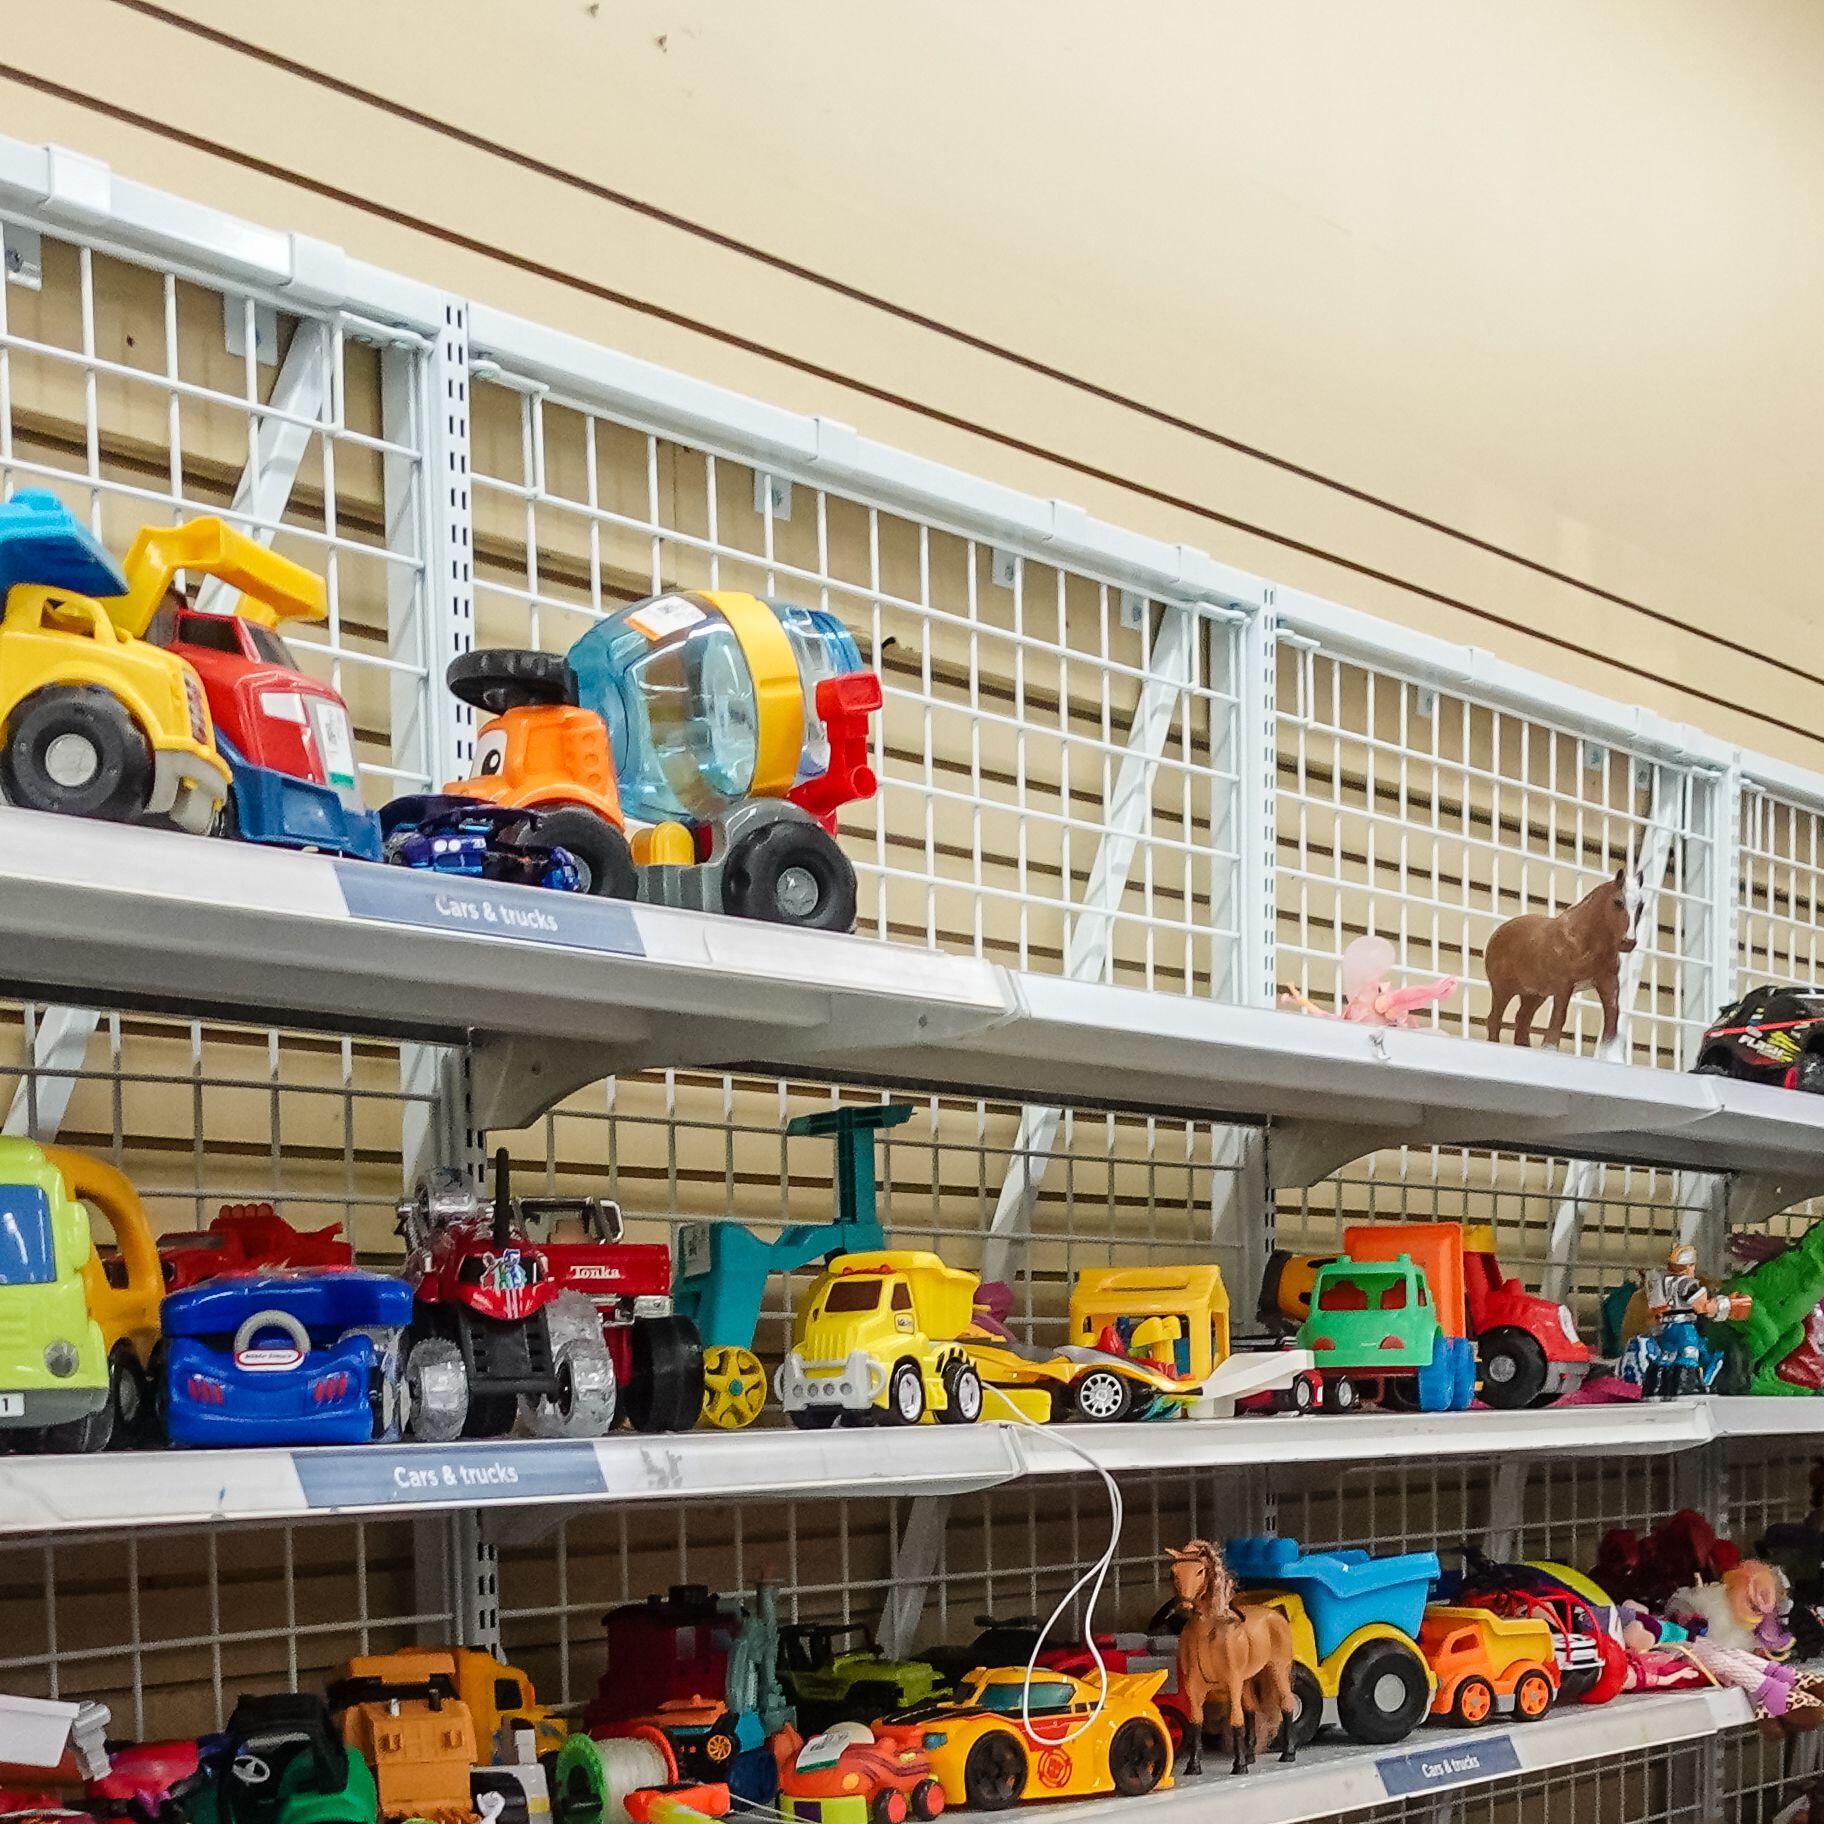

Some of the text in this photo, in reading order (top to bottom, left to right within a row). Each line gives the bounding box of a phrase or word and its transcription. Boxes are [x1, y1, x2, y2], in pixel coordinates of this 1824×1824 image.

[434, 893, 559, 931] Cars & trucks
[570, 1265, 621, 1280] Tonka
[2, 1397, 9, 1413] 1
[393, 1461, 519, 1489] Cars & trucks
[1421, 1754, 1480, 1778] Cars & trucks
